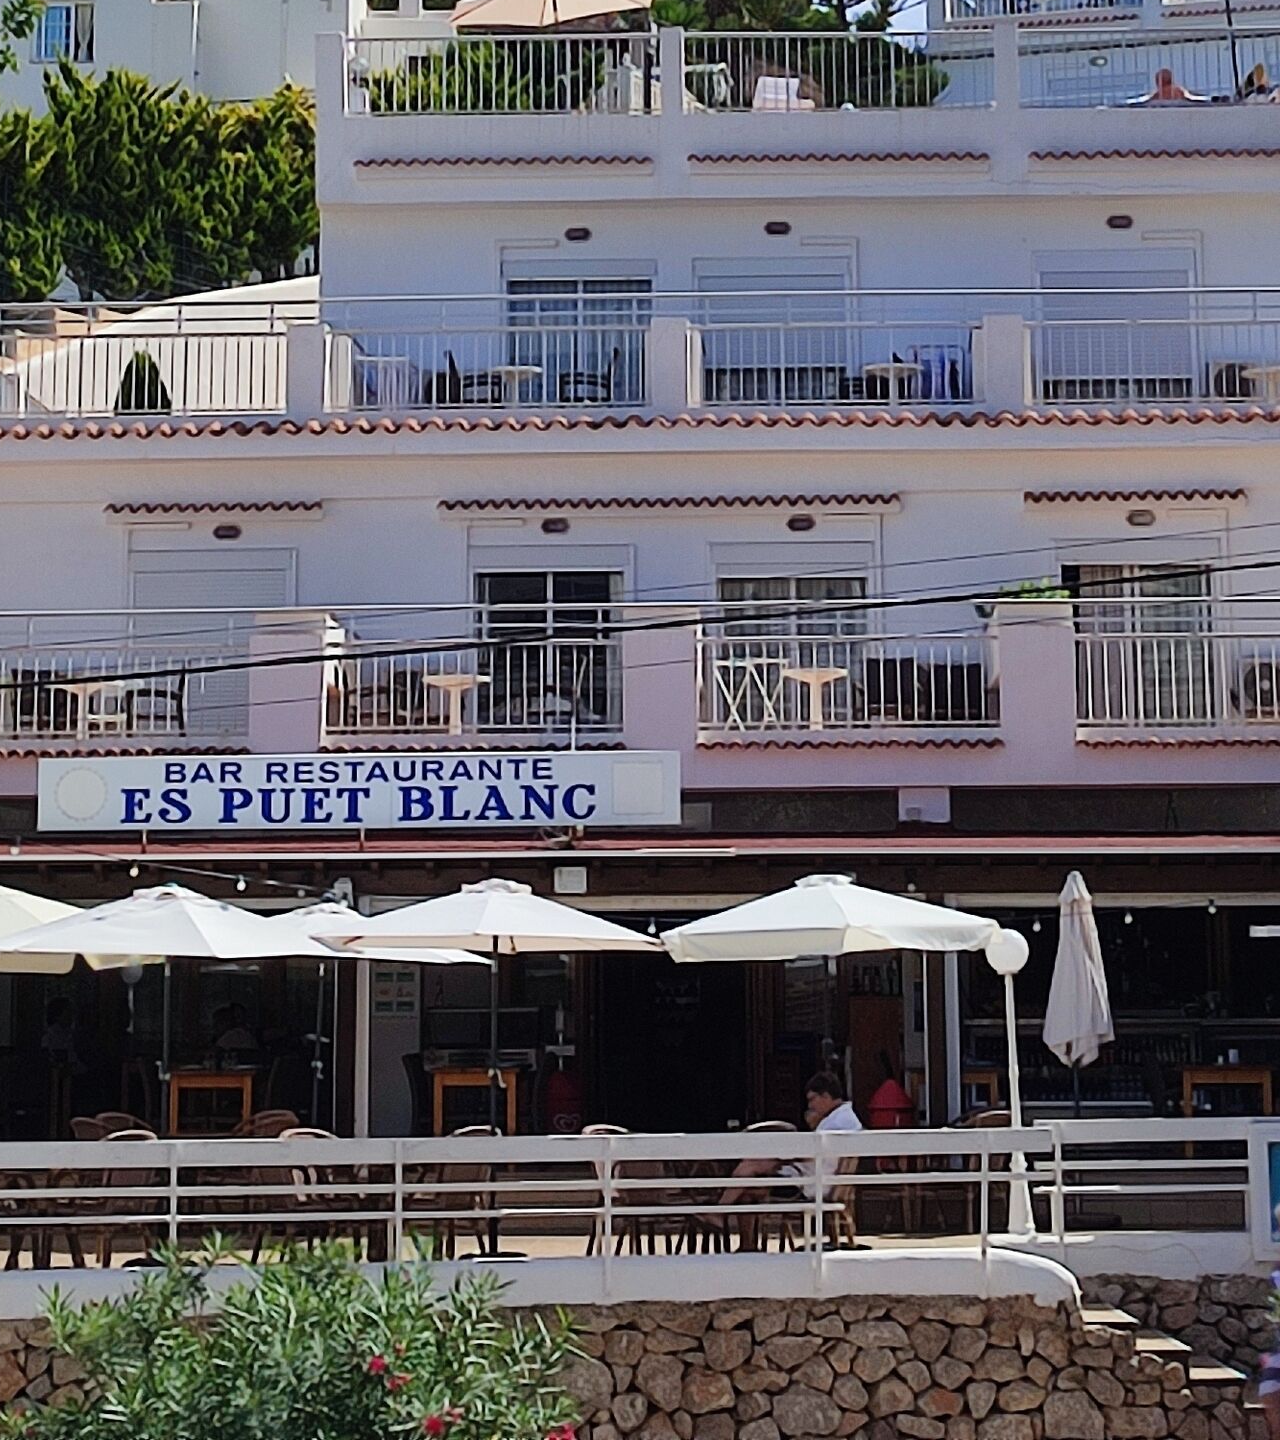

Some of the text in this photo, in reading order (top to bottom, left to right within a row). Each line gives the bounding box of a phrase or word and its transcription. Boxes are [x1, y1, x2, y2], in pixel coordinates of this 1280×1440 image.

[164, 759, 554, 784] BAR RESTAURANTE
[120, 783, 597, 824] ES PUET BLANC
